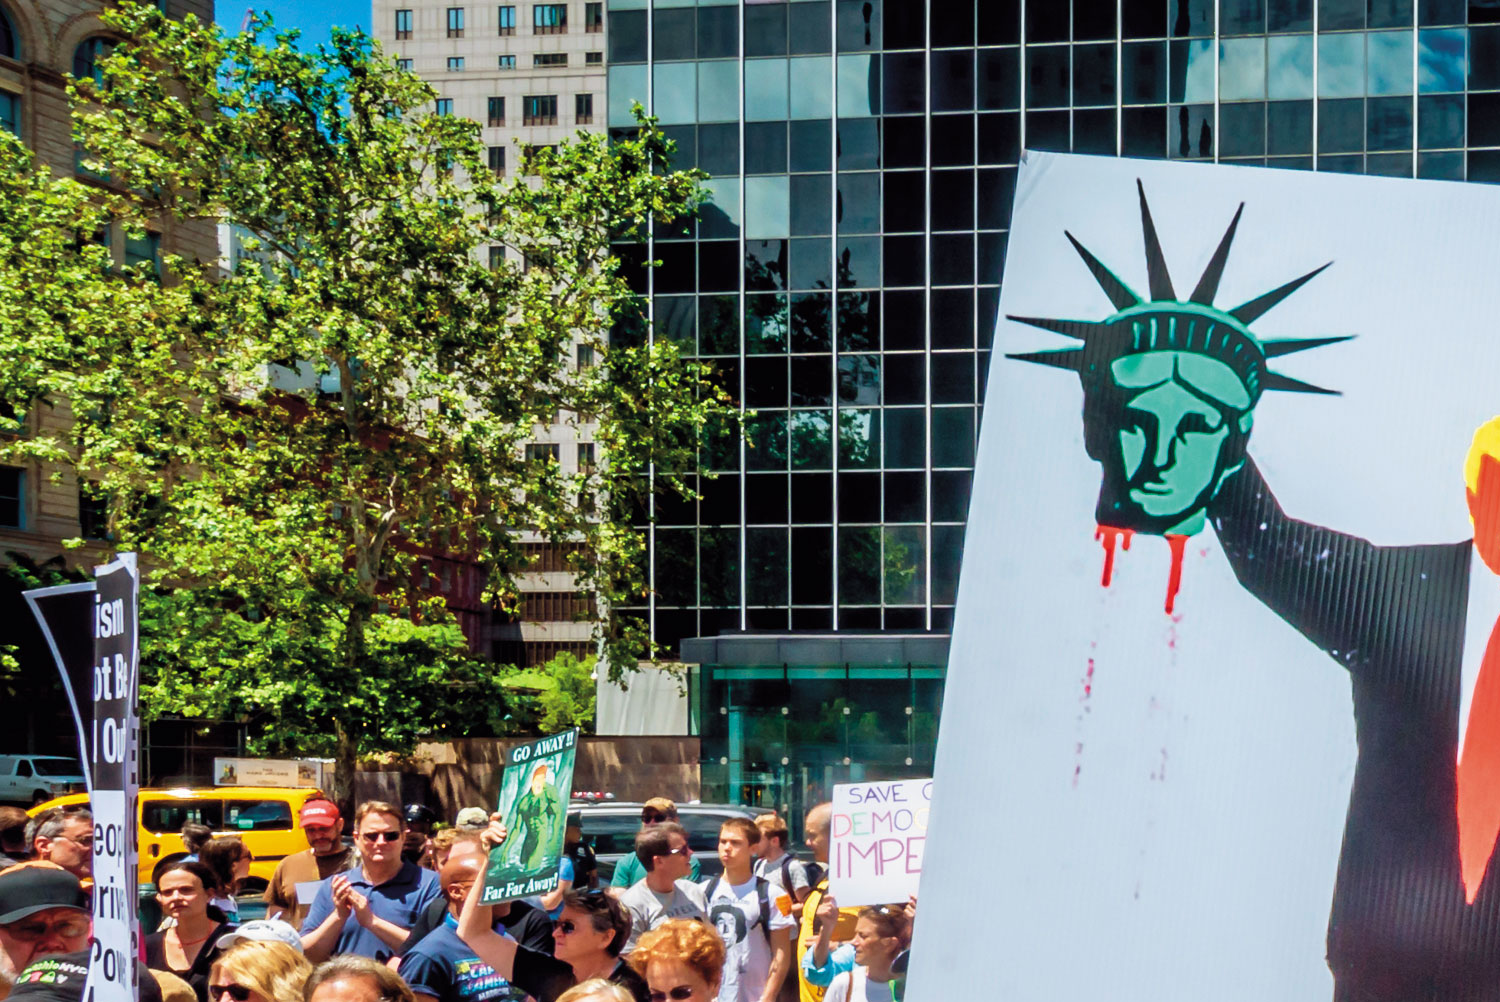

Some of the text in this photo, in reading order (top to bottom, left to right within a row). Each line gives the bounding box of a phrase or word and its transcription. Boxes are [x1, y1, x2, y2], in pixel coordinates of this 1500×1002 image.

[512, 745, 530, 762] GO
[849, 784, 908, 804] SAVE
[837, 836, 926, 878] IMPE
[483, 873, 558, 900] Far Far Away!
